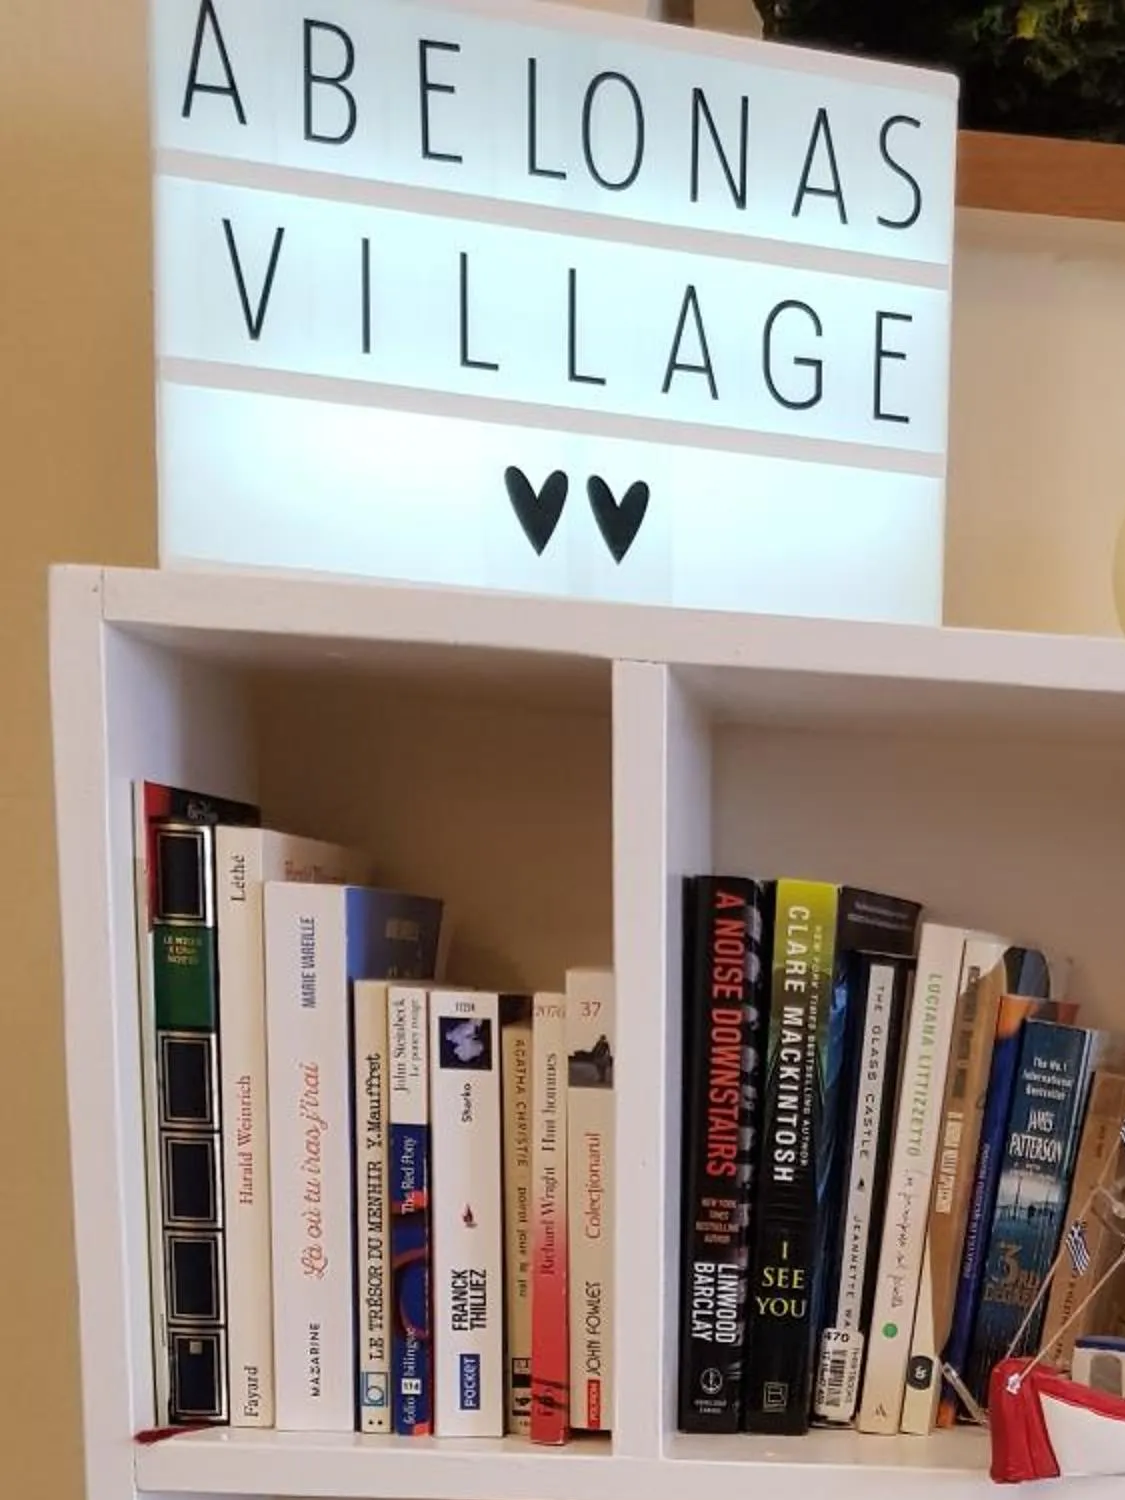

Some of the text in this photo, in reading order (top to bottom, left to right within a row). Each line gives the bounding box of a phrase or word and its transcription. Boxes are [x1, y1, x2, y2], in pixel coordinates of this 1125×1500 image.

[181, 3, 923, 230] ABELONAS
[222, 218, 913, 424] VILLAGE
[299, 917, 317, 1009] MARIE VAREILLE
[705, 891, 745, 1177] A NOISE DOWNSTAIRS
[772, 904, 810, 1182] CLARE MACKINTOSH
[906, 972, 943, 1158] LUCIANA LITTIZZETTO
[860, 984, 886, 1160] THE GLASS CASTLE
[235, 1076, 252, 1205] Harald Weinrich
[1008, 1132, 1061, 1163] PATTERSON
[366, 1161, 383, 1233] MENHIR
[367, 1236, 383, 1260] DU
[761, 1266, 805, 1289] SEE
[847, 1216, 862, 1299] JEANNETTE
[364, 1264, 383, 1332] TRÉSOR
[451, 1269, 468, 1332] FRANCK
[469, 1268, 487, 1330] THILLIEZ
[691, 1262, 715, 1343] BARCLAY
[714, 1263, 739, 1344] LINWOOD
[755, 1296, 808, 1318] YOU
[309, 1323, 321, 1397] MAZARINE
[368, 1338, 384, 1361] LE
[462, 1357, 477, 1408] POCKET
[243, 1366, 260, 1418] Fayard
